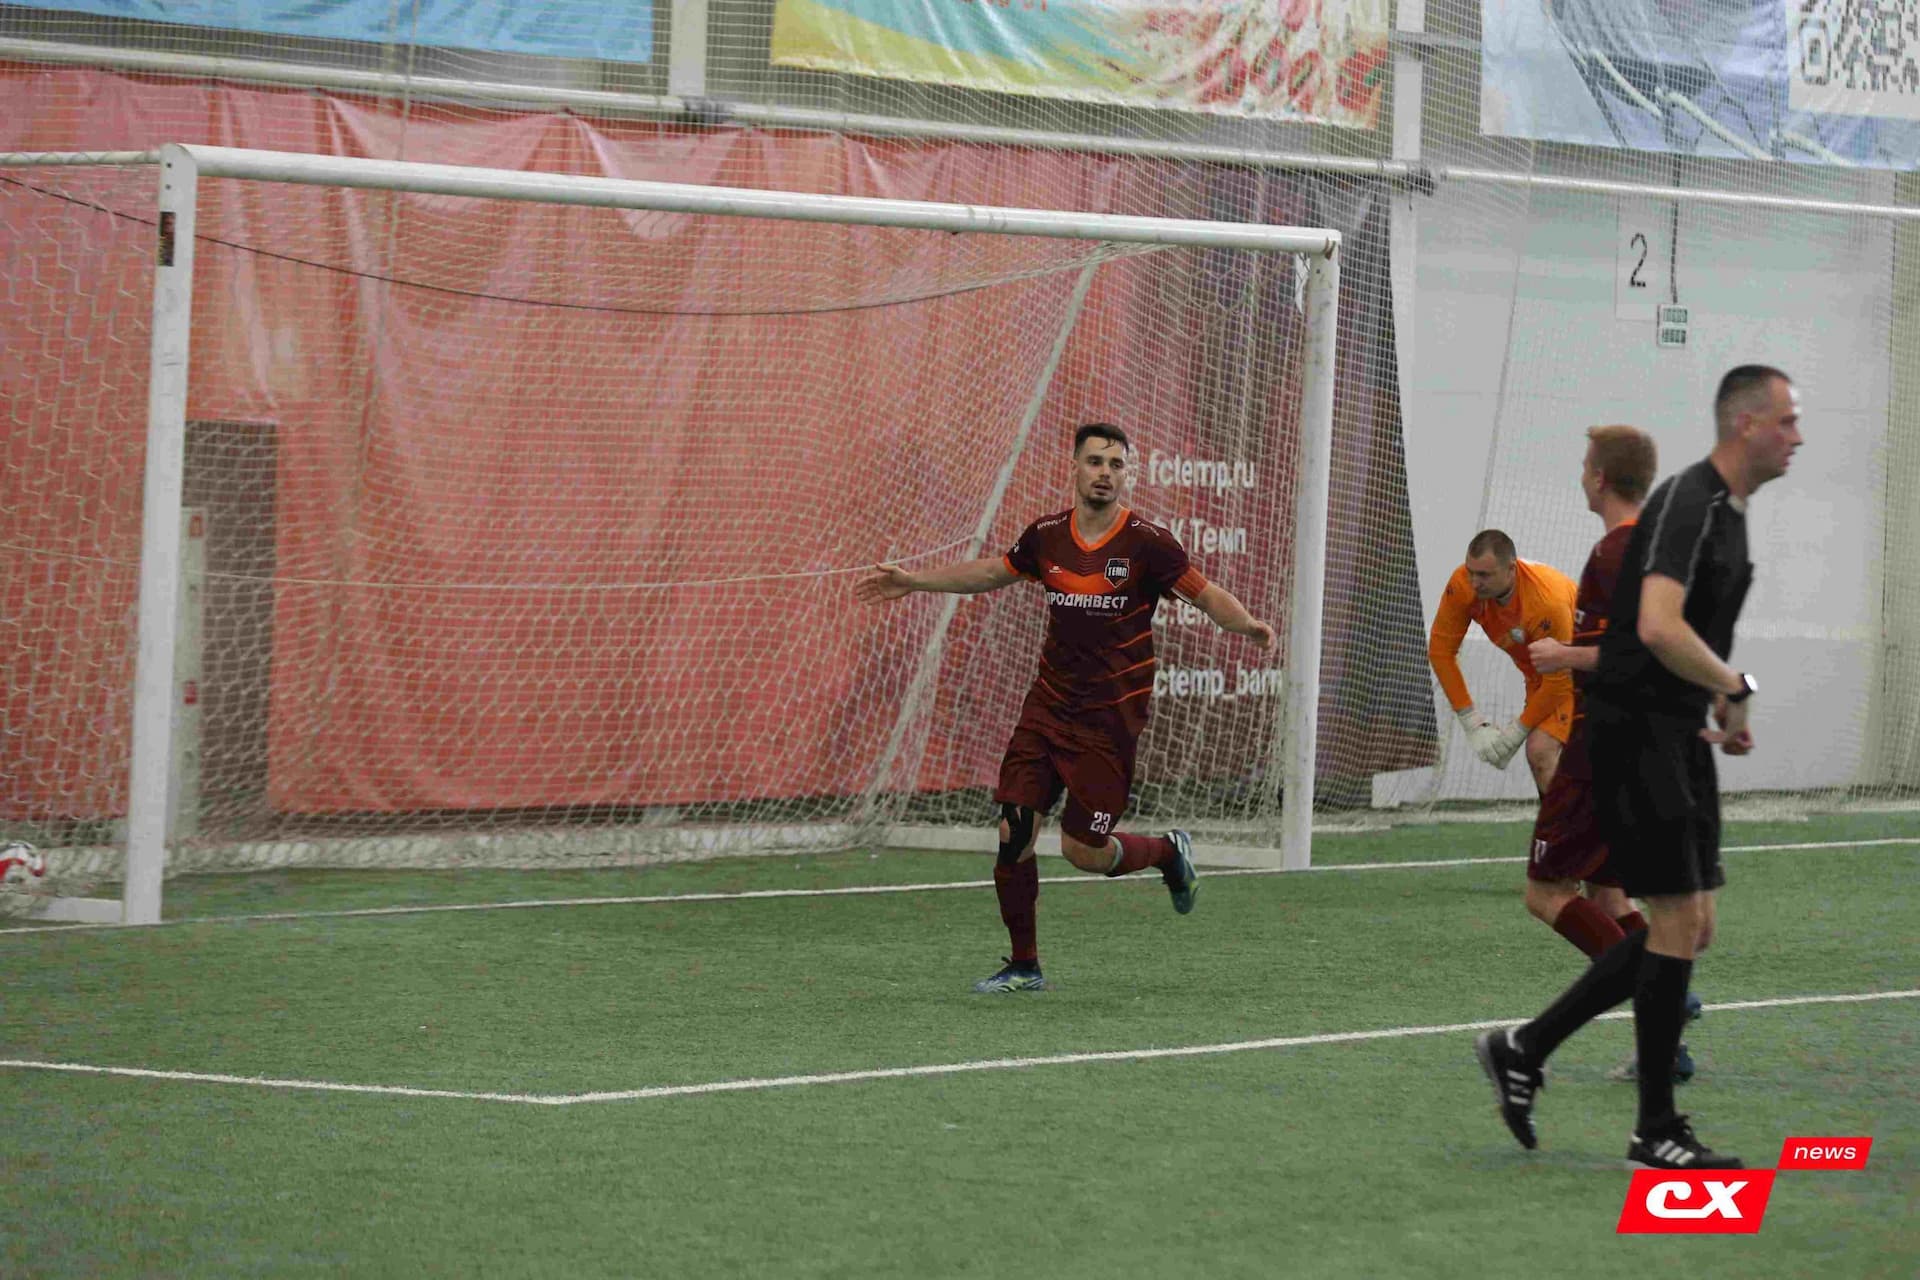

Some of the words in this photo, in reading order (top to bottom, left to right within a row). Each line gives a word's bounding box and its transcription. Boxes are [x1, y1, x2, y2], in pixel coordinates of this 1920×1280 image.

[1630, 232, 1647, 288] 2
[1149, 452, 1255, 496] fctemp.ru
[1190, 518, 1246, 554] Темп
[1107, 566, 1128, 577] ТЕМП
[1090, 811, 1111, 834] 23
